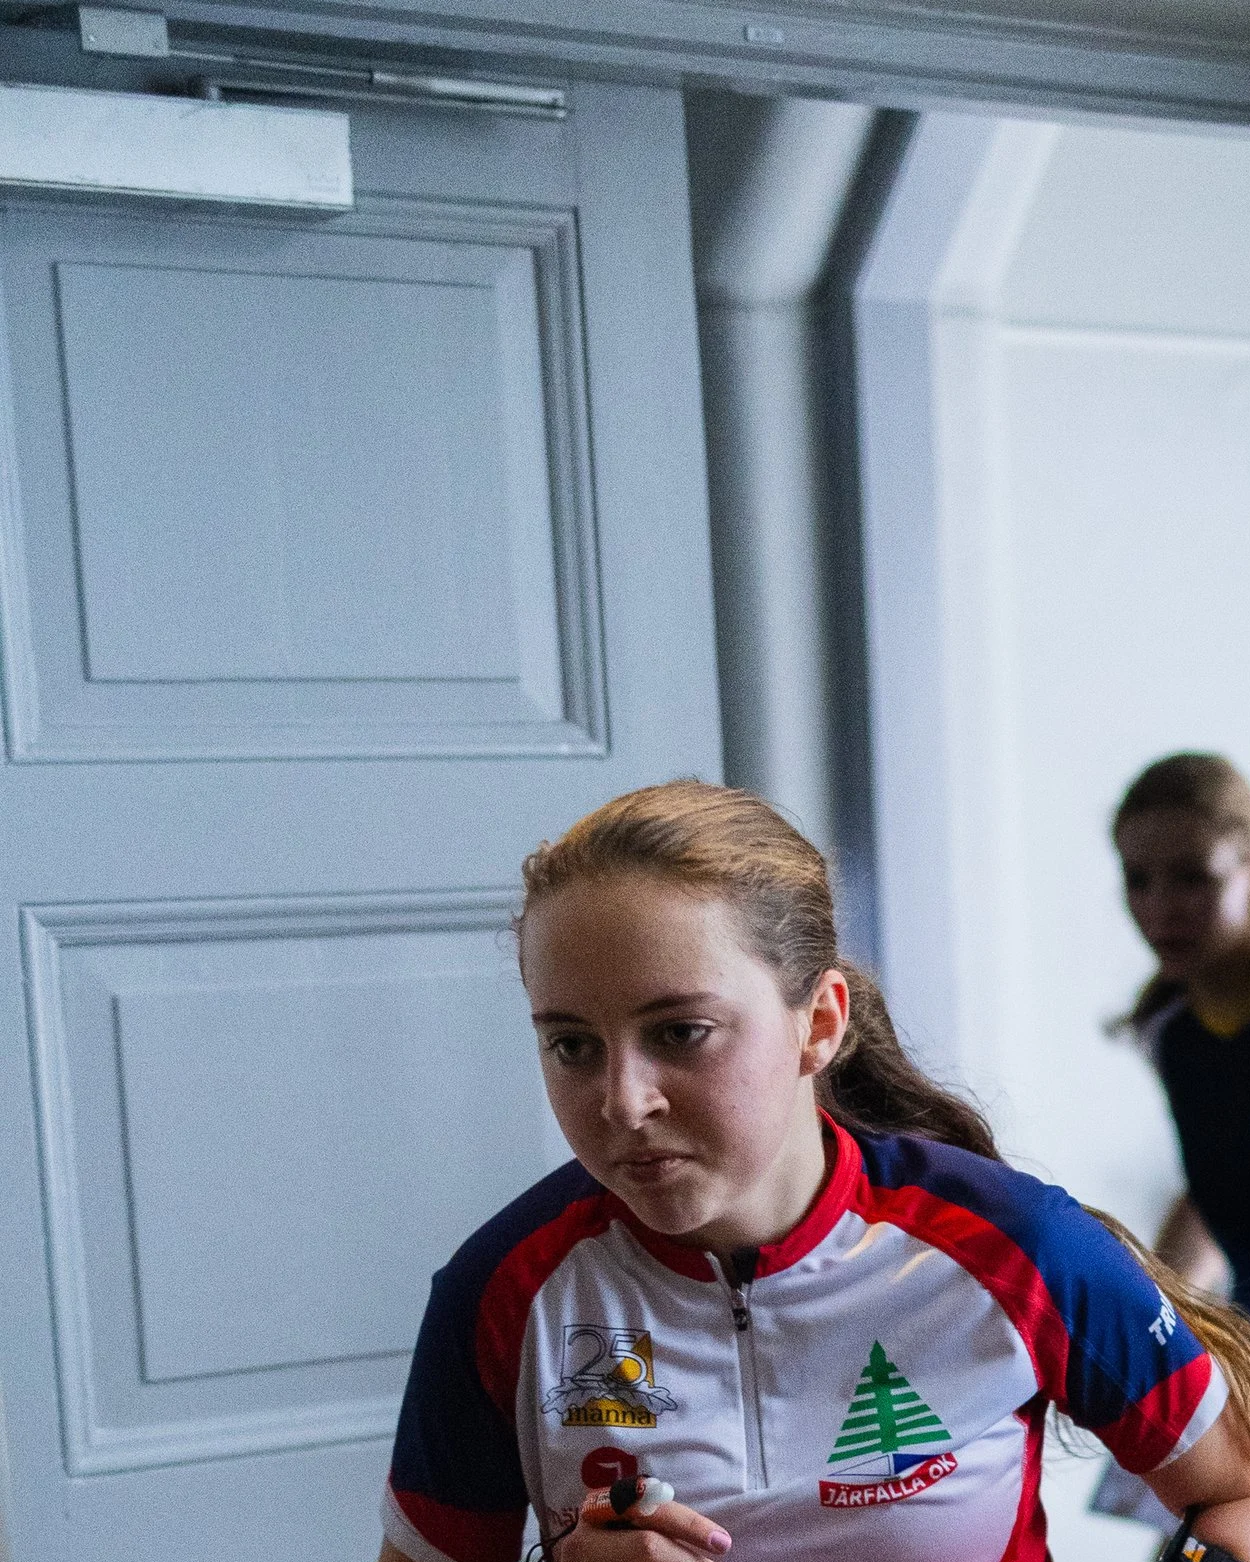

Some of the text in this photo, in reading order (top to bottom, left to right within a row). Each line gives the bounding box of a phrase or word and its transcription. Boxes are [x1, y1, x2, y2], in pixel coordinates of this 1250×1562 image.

[568, 1330, 647, 1387] 25
[567, 1406, 653, 1425] manna
[928, 1454, 957, 1480] OK
